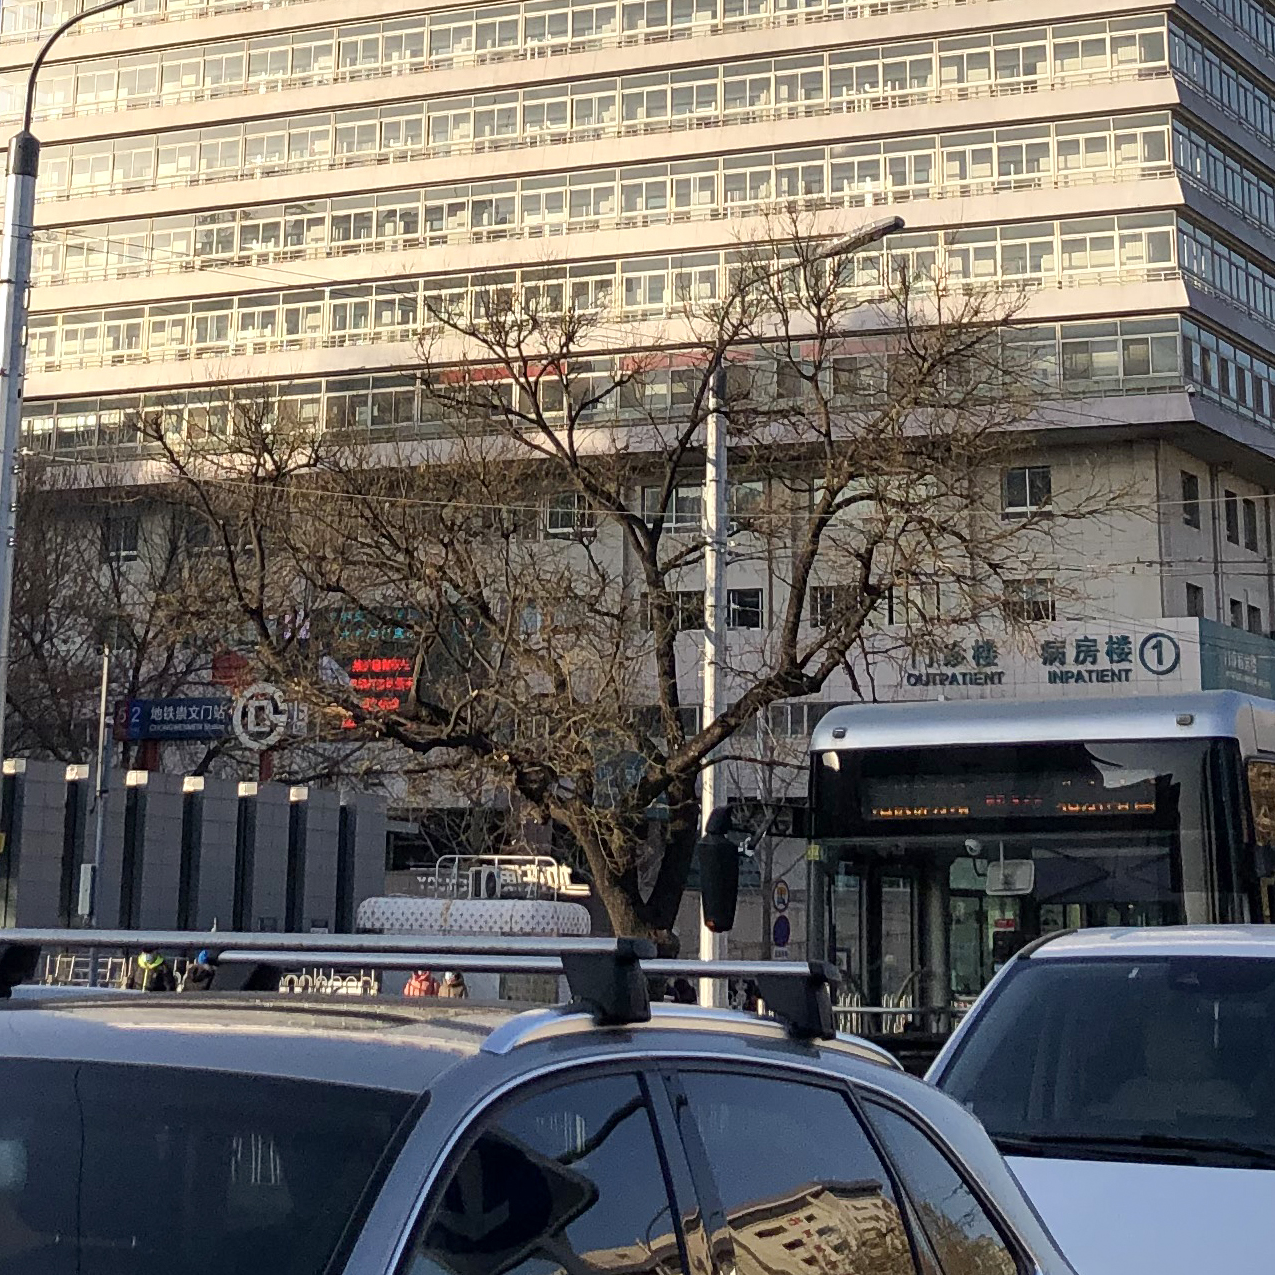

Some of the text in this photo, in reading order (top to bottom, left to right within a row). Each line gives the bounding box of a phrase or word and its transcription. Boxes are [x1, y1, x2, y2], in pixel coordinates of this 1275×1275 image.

[911, 638, 999, 669] 门诊楼
[1040, 635, 1133, 666] 病房楼
[907, 668, 1133, 686] OUTPATIENT INPATIENT
[131, 706, 141, 723] 2
[150, 704, 227, 721] 地铁崇文门站
